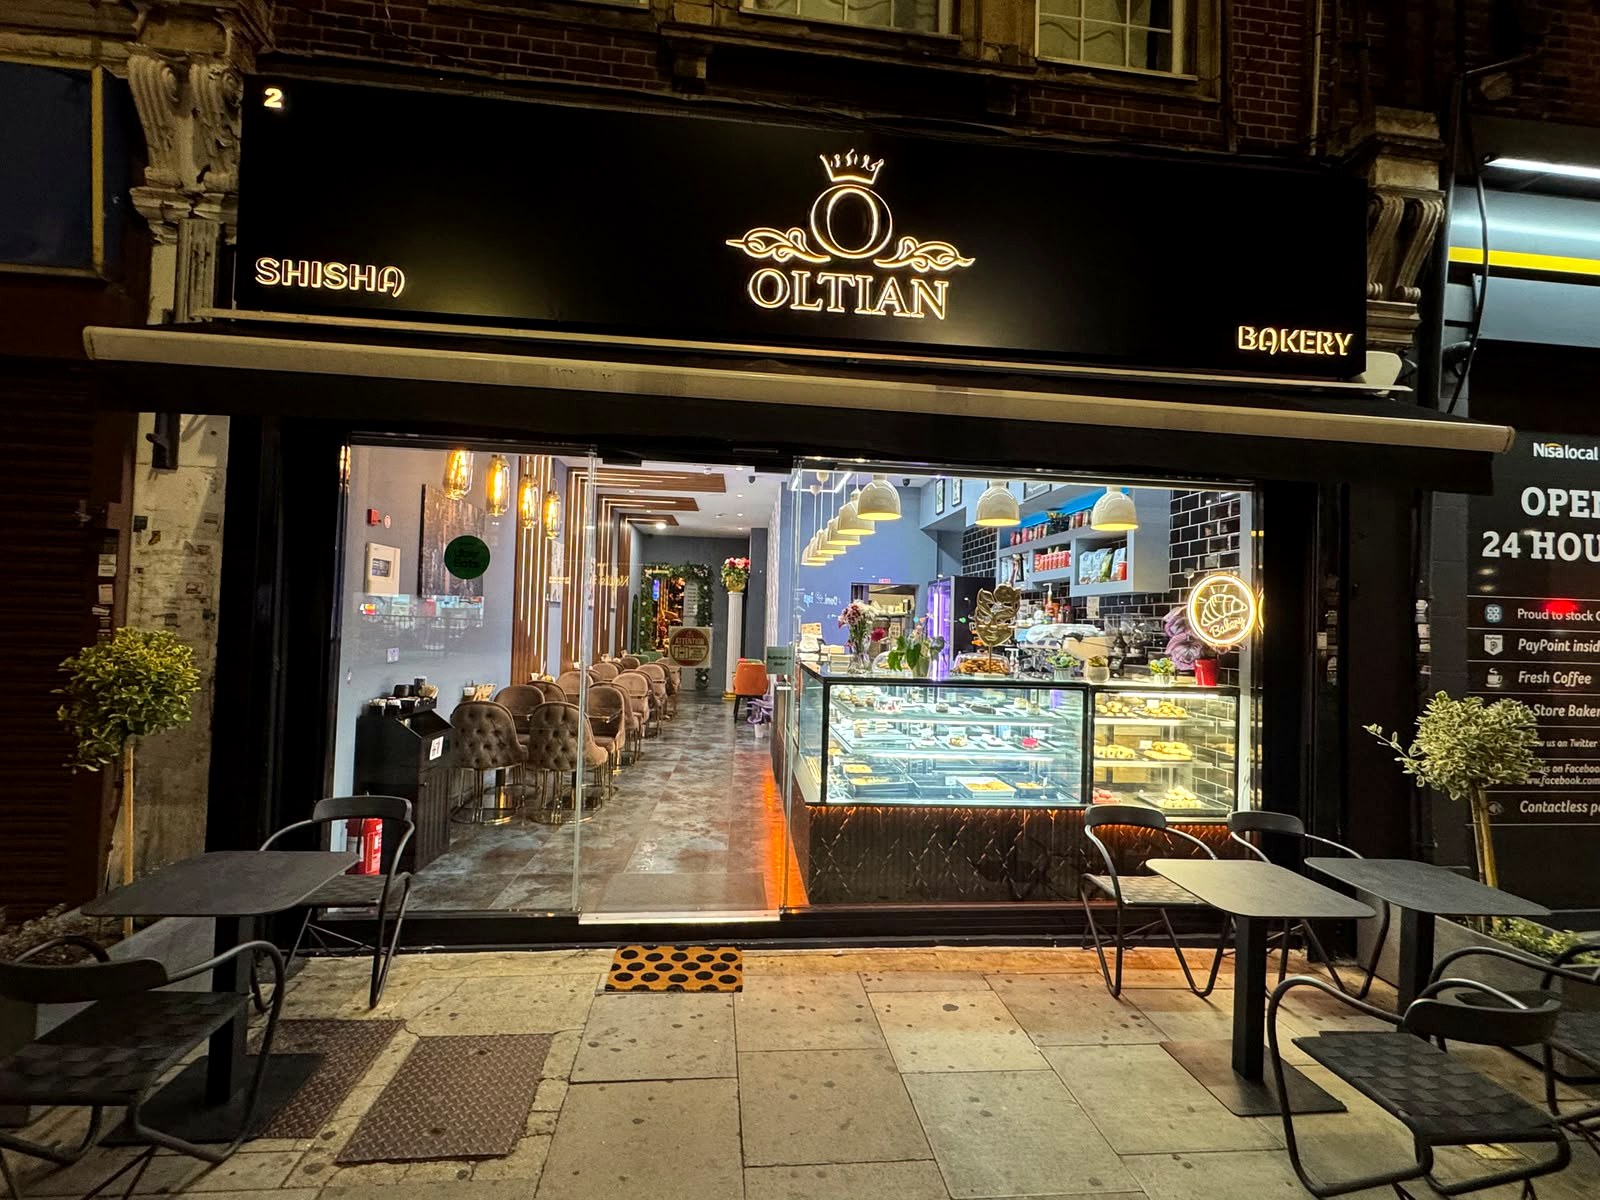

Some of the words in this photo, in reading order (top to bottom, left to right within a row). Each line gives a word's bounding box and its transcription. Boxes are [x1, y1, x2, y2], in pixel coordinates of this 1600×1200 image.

[263, 87, 284, 108] 2
[255, 257, 406, 298] SHISHA
[748, 268, 949, 321] OLTIAN
[1238, 325, 1353, 356] BAKERY
[1482, 531, 1521, 560] 24
[1517, 608, 1549, 620] Proud
[1552, 610, 1563, 620] to
[1565, 609, 1594, 621] stock
[1209, 617, 1246, 638] Bakery
[1518, 638, 1571, 655] PayPoint
[1518, 670, 1550, 684] Fresh
[1553, 671, 1592, 687] Coffee
[1533, 704, 1565, 717] Store
[1570, 738, 1598, 748] Twitter
[1552, 765, 1564, 773] on
[1519, 799, 1589, 813] Contactless
